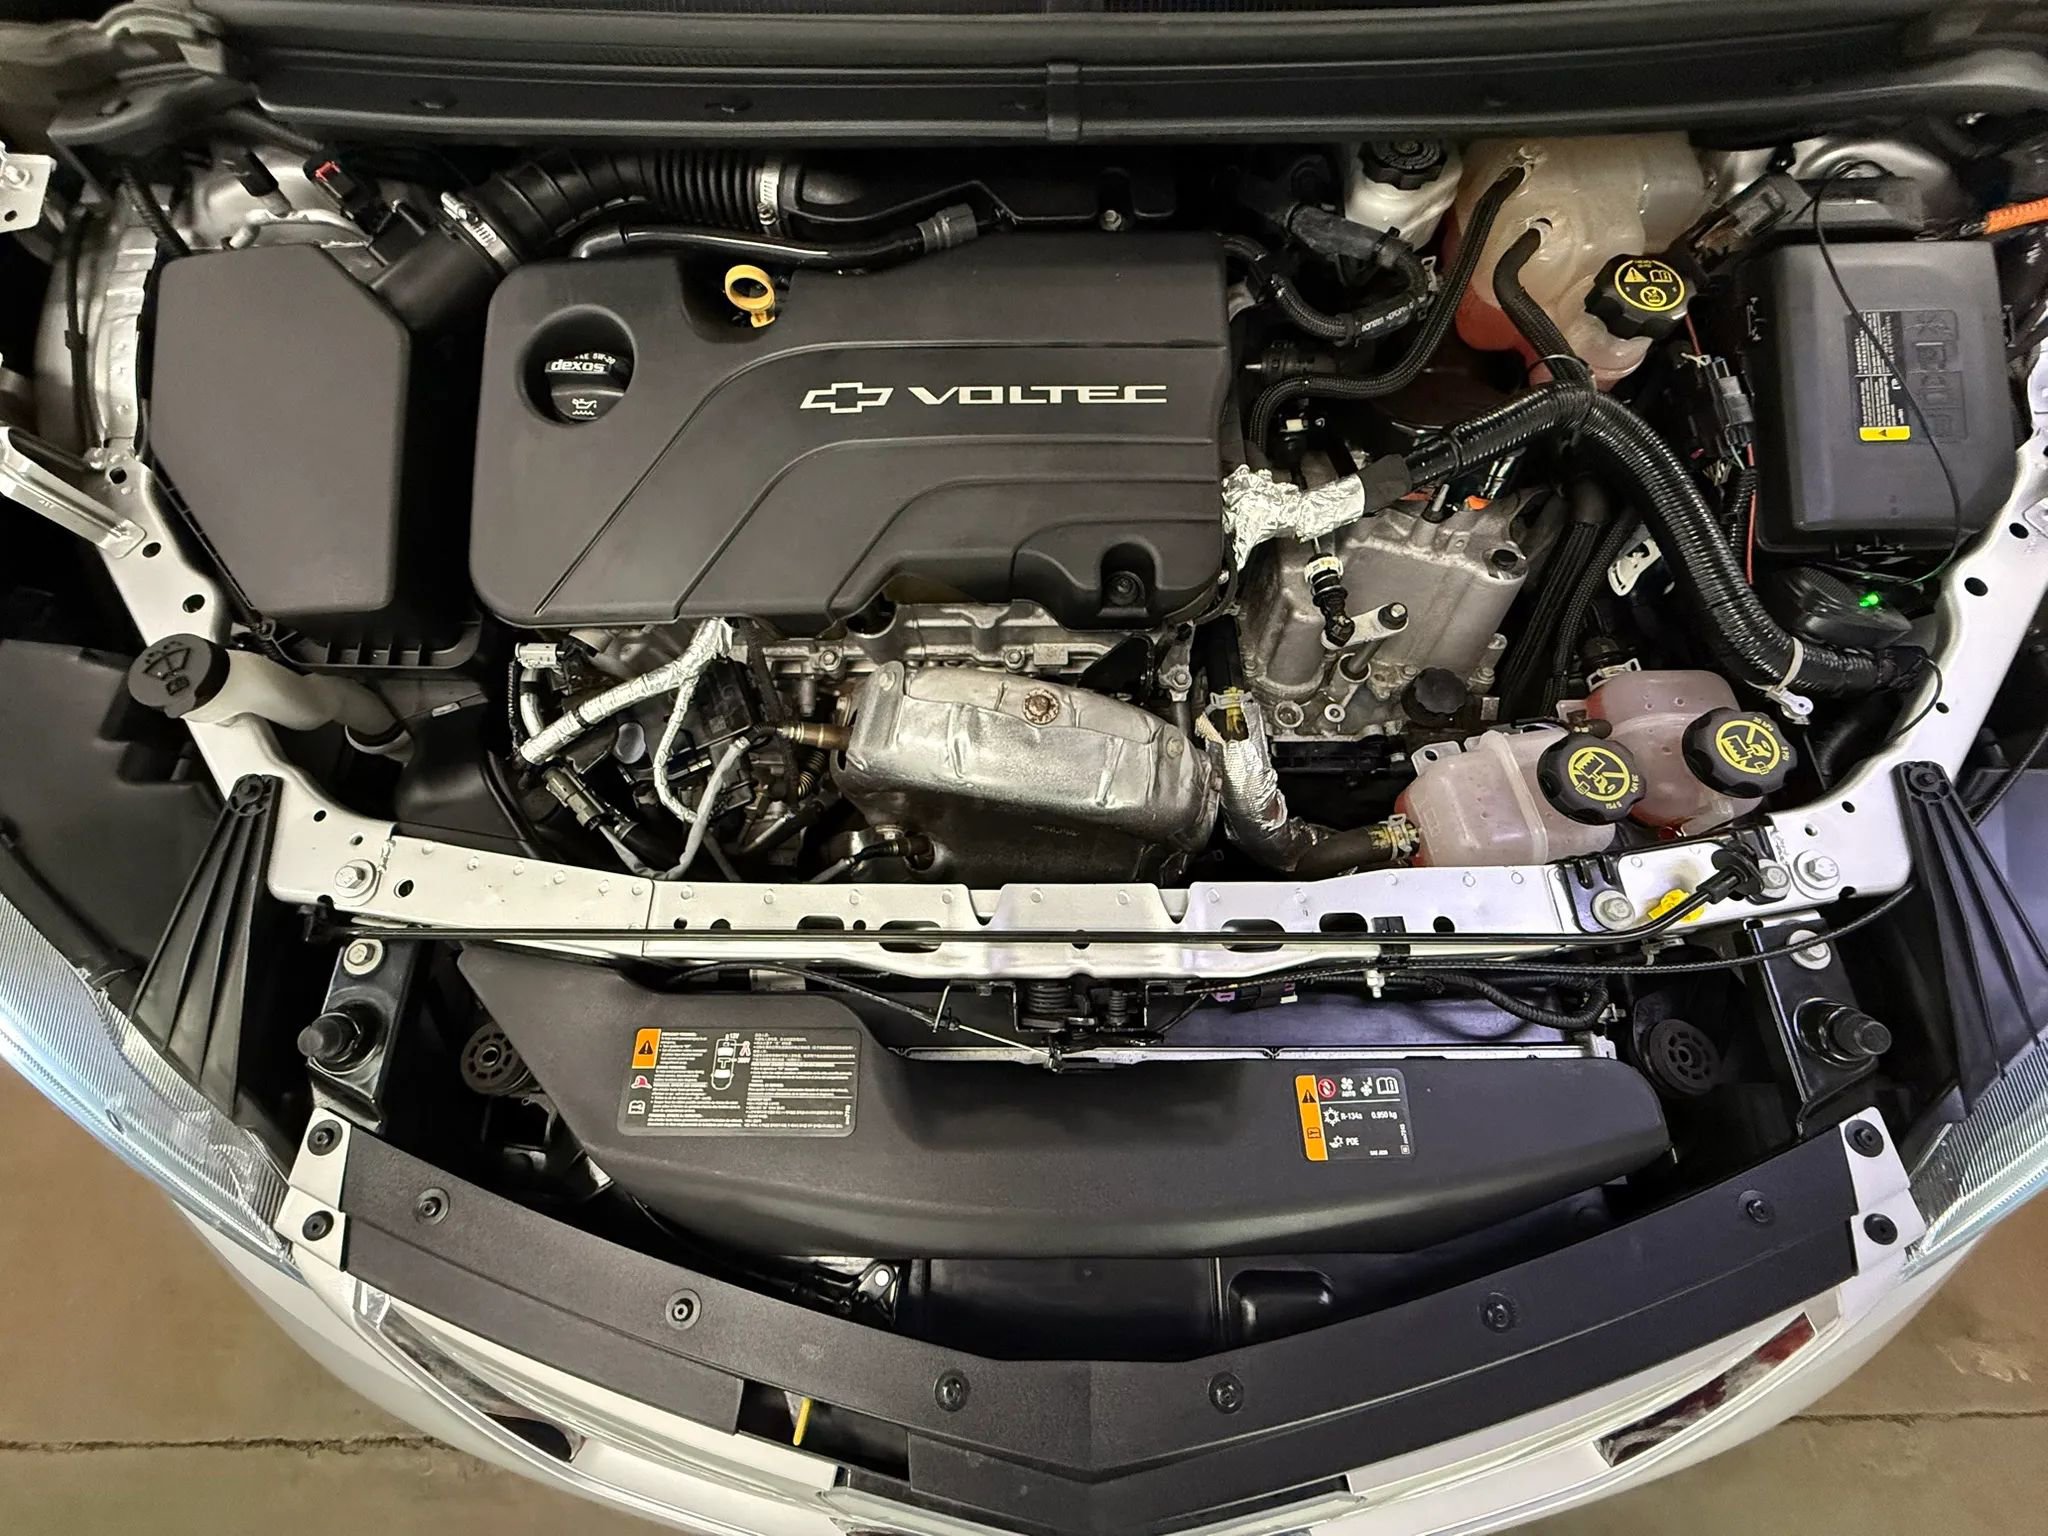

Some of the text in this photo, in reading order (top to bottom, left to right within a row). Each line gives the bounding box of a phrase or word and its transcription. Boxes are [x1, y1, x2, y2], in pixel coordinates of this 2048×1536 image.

[551, 359, 606, 373] dexos
[908, 385, 1167, 404] VOLTEC
[1340, 1112, 1363, 1120] R-134a
[1389, 1111, 1398, 1120] kg
